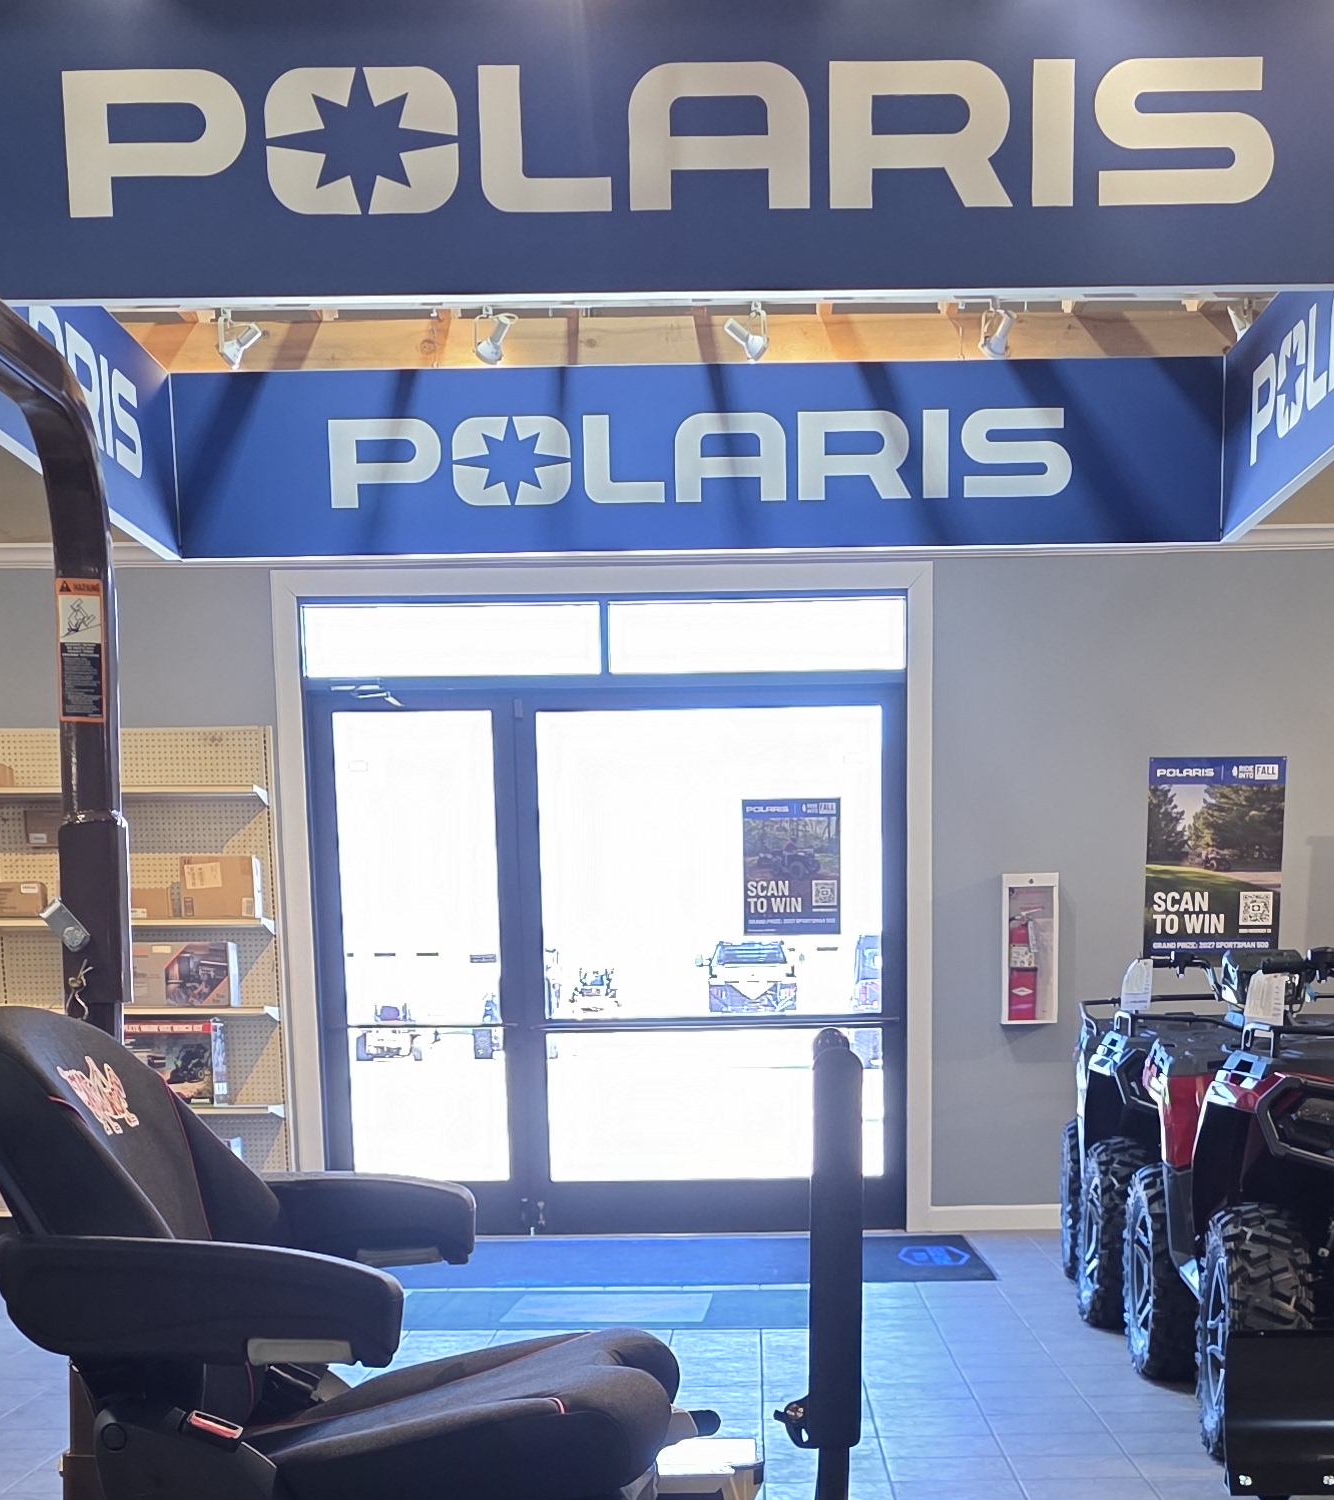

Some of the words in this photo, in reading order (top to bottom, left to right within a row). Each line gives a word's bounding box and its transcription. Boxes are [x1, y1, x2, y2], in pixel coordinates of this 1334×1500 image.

[62, 56, 1275, 218] POLARIS
[328, 408, 1073, 509] POLARIS
[1156, 768, 1215, 777] POLARIS
[1256, 766, 1277, 776] FALL
[747, 881, 789, 896] SCAN
[747, 898, 767, 913] TO
[770, 897, 802, 913] WIN
[1153, 891, 1209, 912] SCAN
[1152, 914, 1179, 934] TO
[1184, 914, 1225, 934] WIN
